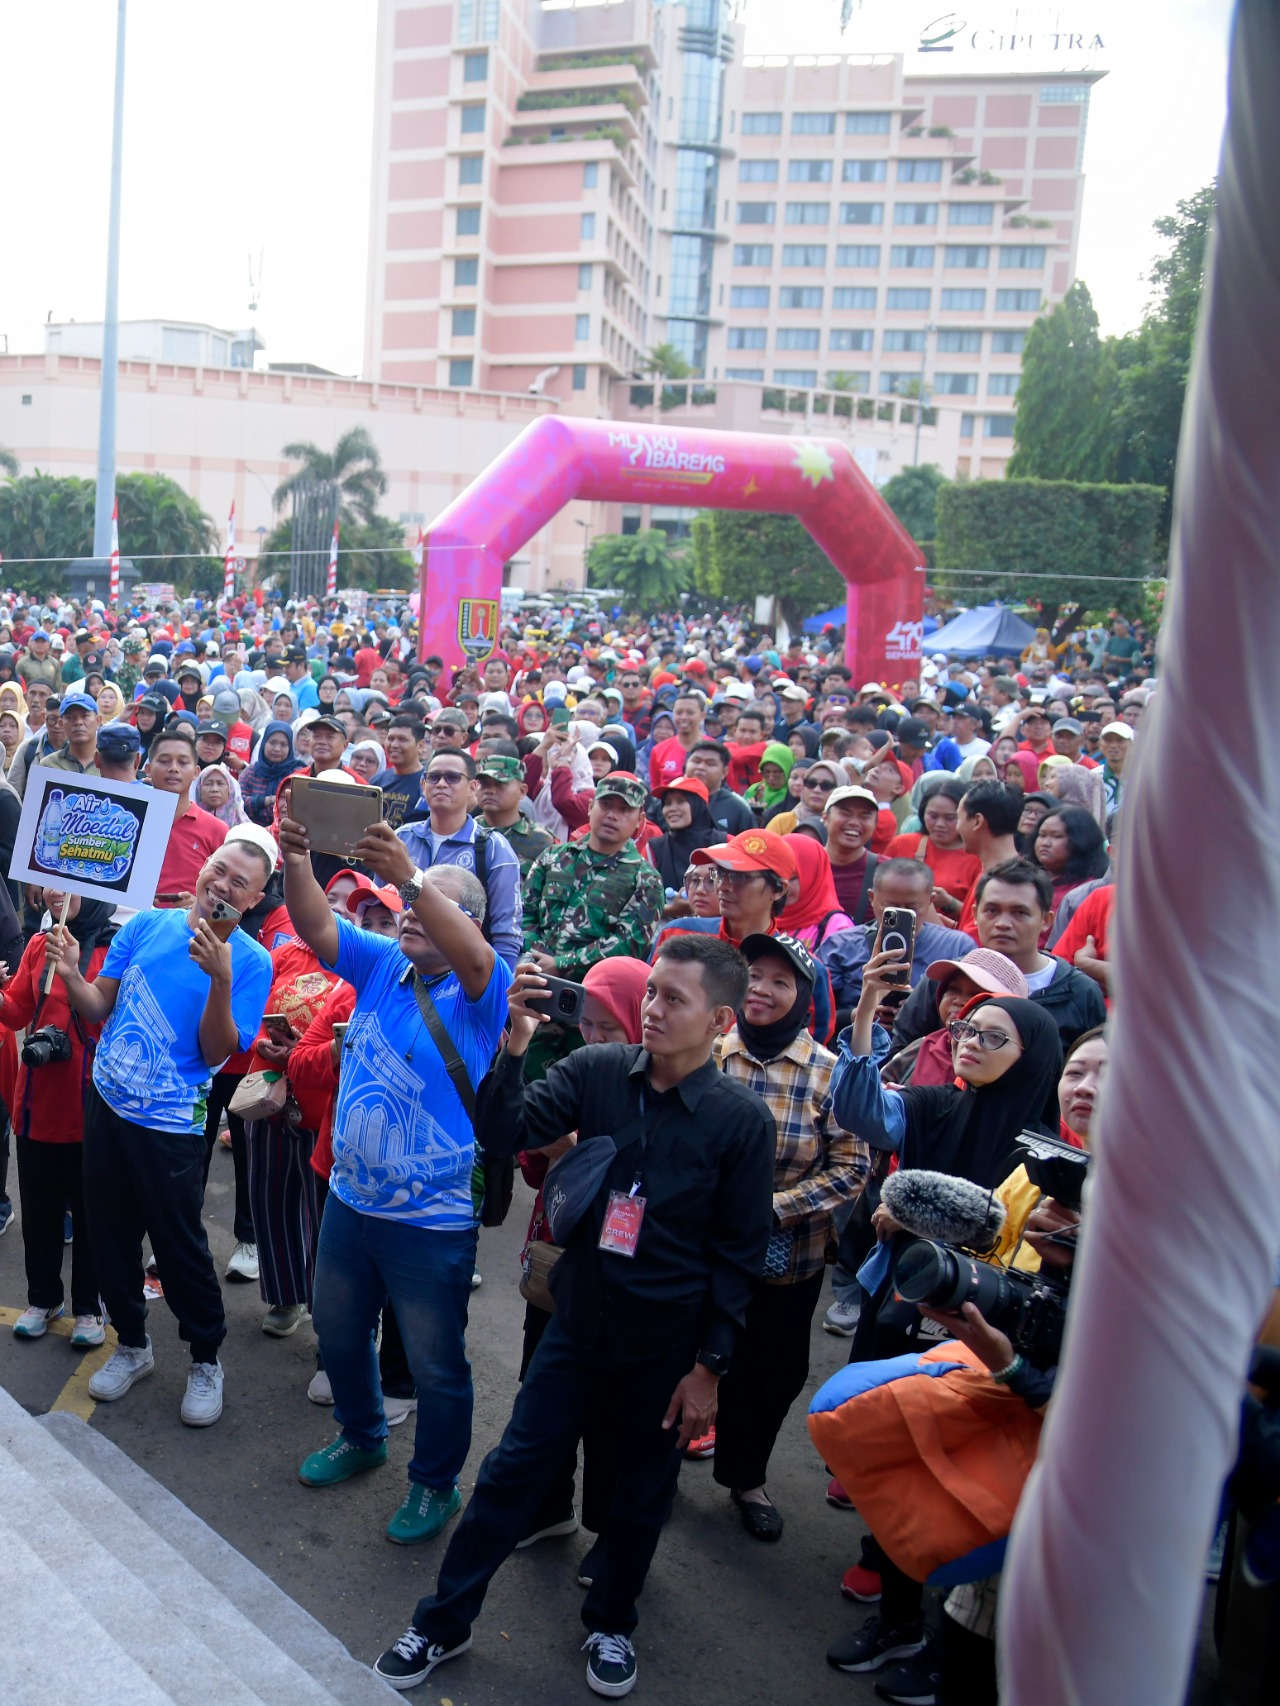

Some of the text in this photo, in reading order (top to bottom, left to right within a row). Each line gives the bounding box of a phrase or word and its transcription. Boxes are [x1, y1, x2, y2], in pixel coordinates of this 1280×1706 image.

[652, 449, 726, 474] BARENG
[73, 795, 101, 814] Air
[59, 812, 137, 840] Moedal
[67, 835, 108, 848] Sumber
[59, 843, 114, 861] Sehatmu
[605, 1227, 635, 1240] CREW
